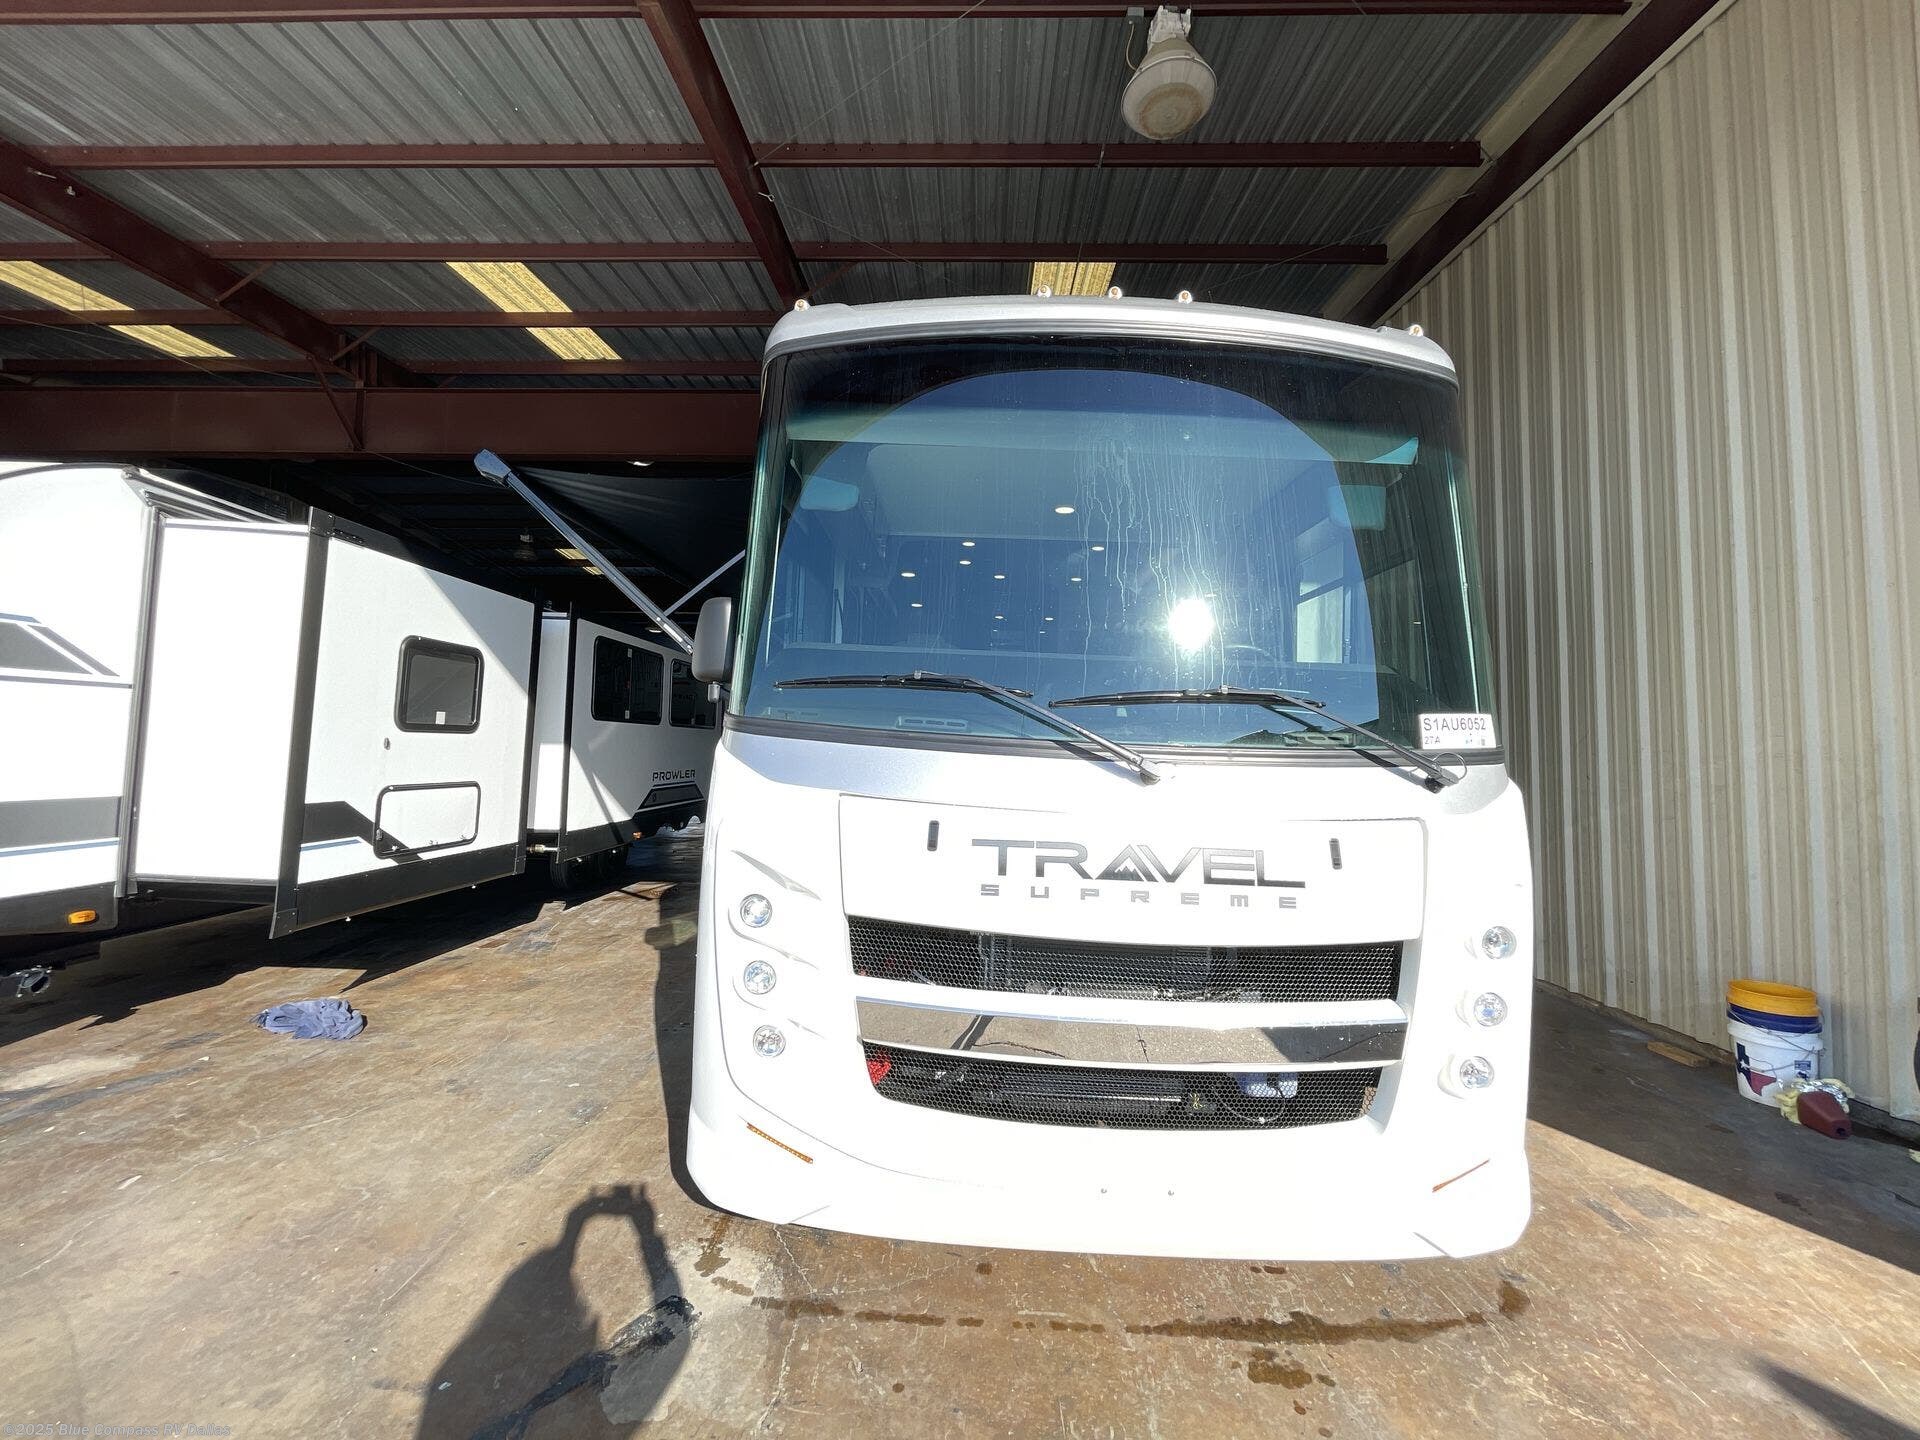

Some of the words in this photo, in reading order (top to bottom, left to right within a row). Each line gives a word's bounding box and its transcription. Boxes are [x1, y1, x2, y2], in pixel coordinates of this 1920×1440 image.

[1423, 718, 1486, 731] S1AU6052
[652, 770, 696, 781] PROWLER
[972, 839, 1306, 888] TRAVEL
[980, 884, 1297, 909] SUPREME
